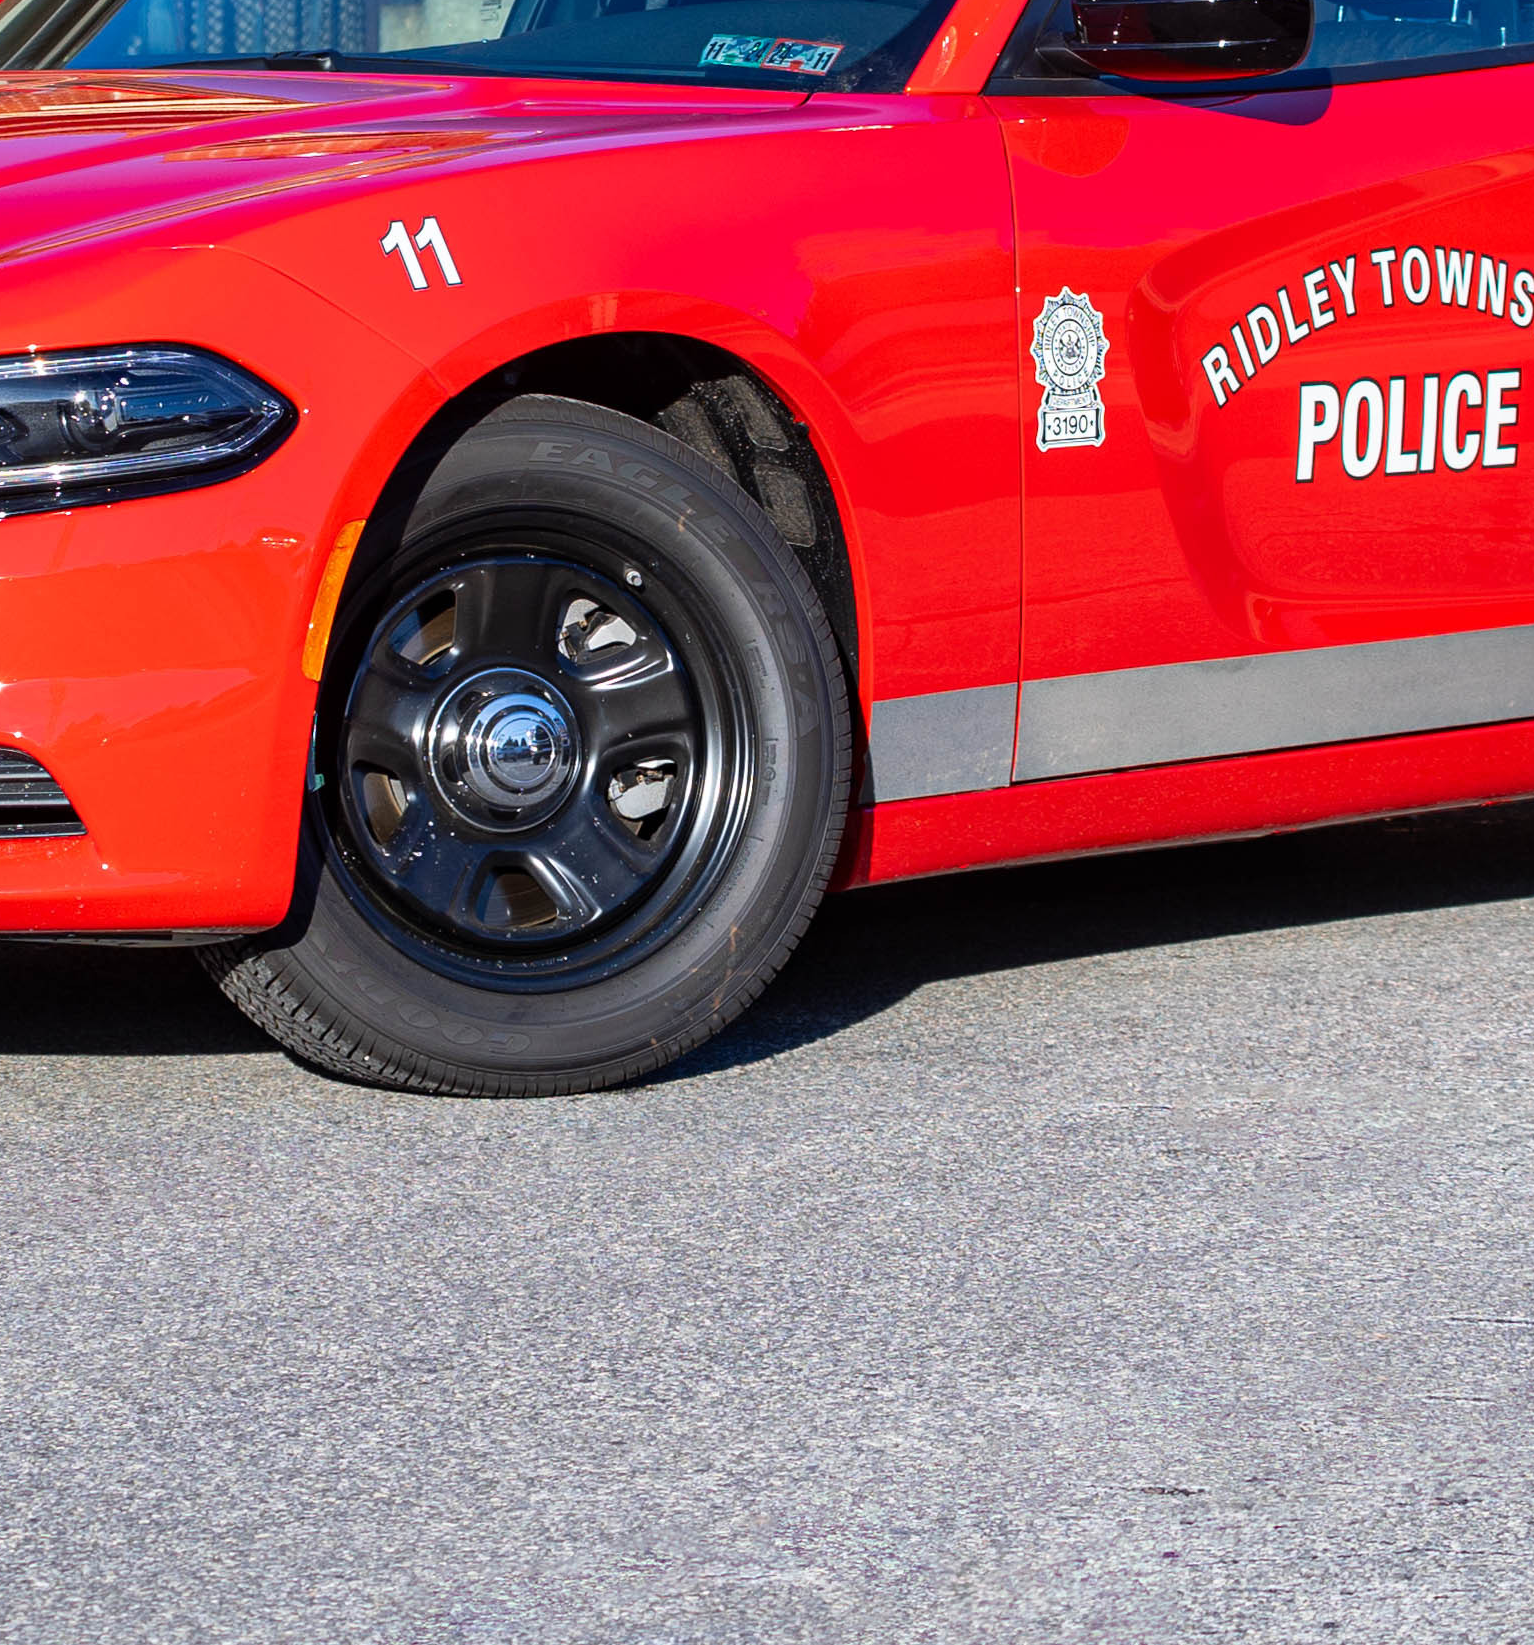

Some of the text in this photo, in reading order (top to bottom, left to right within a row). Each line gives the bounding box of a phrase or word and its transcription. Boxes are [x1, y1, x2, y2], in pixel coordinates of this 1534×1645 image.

[813, 50, 835, 71] 11
[379, 216, 463, 290] 11
[1201, 254, 1356, 407] RIDLEY
[1052, 414, 1088, 436] 3190
[1295, 368, 1522, 483] POLICE
[528, 441, 743, 546] EAGLE
